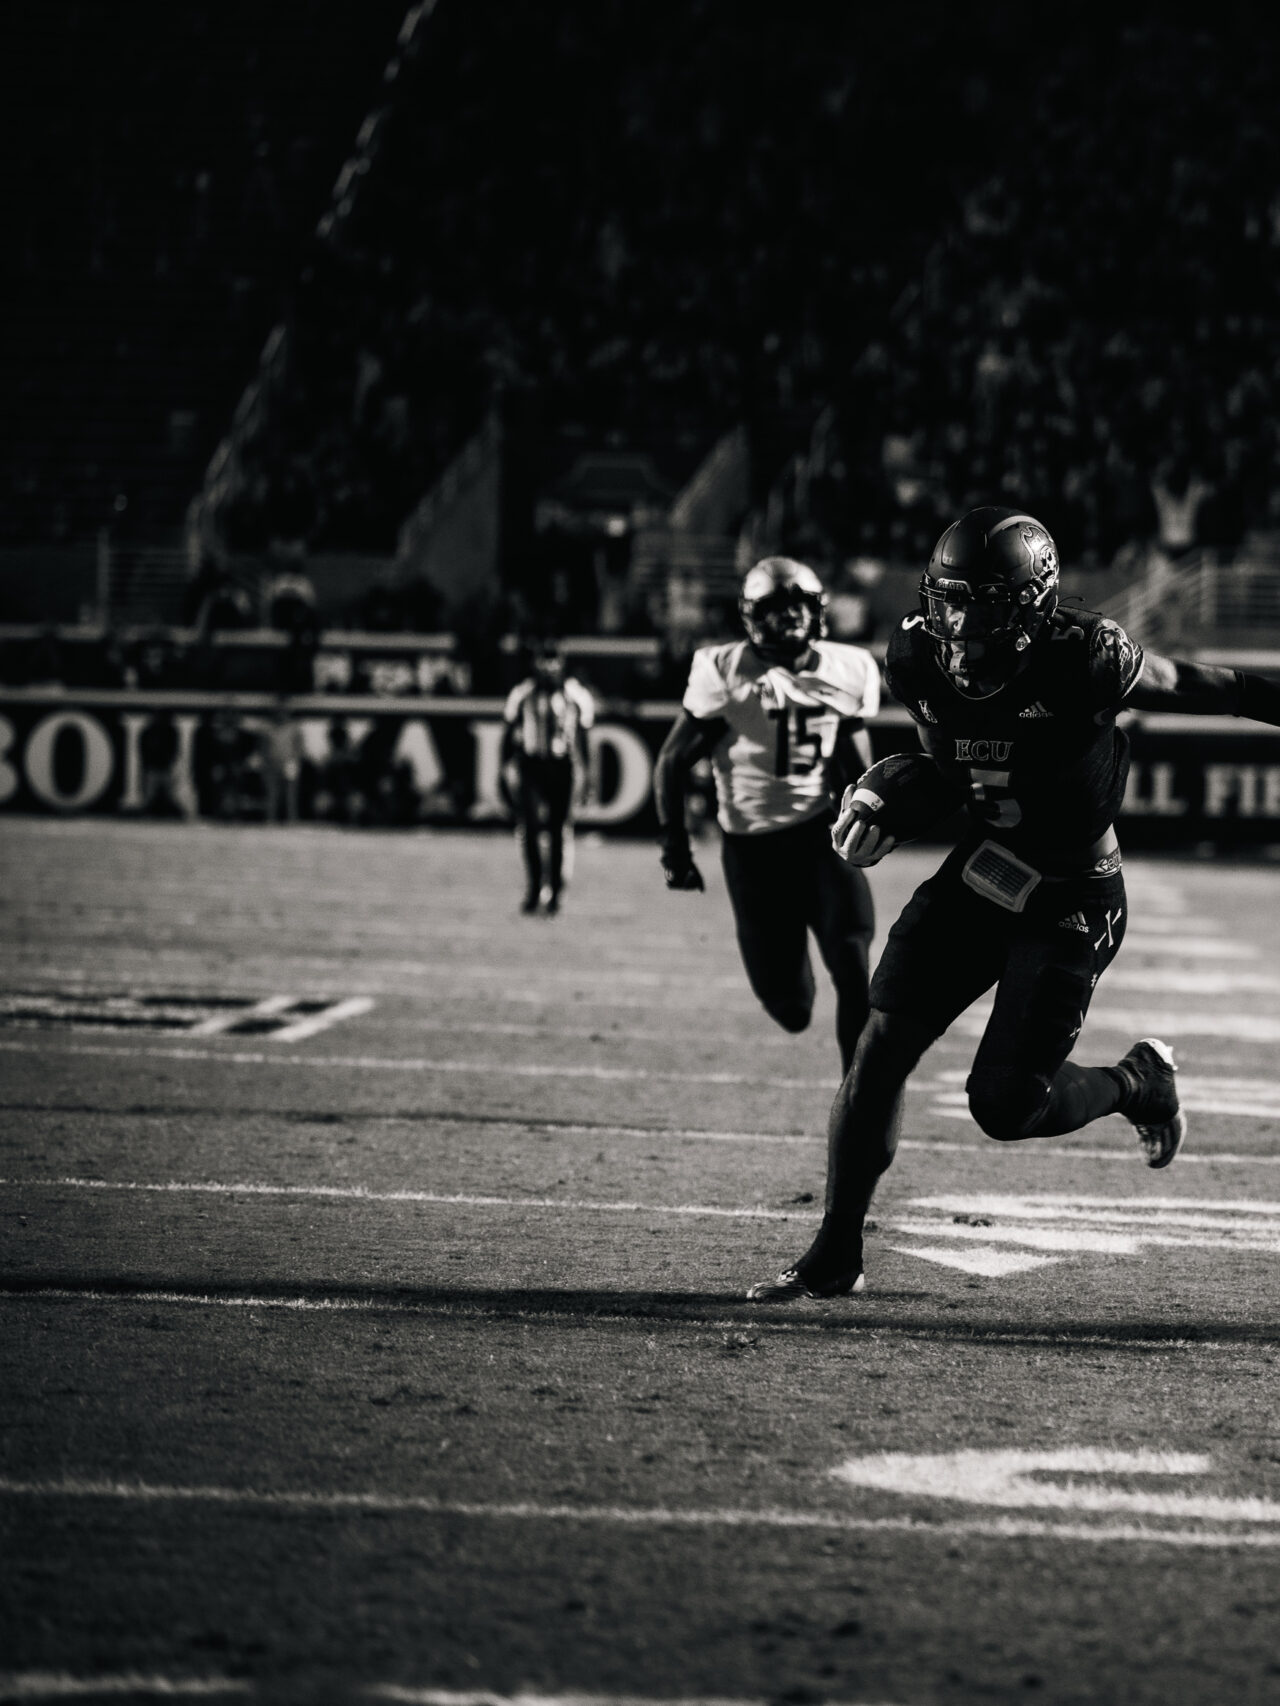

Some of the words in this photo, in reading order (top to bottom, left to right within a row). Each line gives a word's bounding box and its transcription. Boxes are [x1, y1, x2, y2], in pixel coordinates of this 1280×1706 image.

[768, 707, 826, 777] 15
[953, 739, 1015, 763] ECU
[969, 767, 1023, 829] 5
[1058, 919, 1090, 934] adidas
